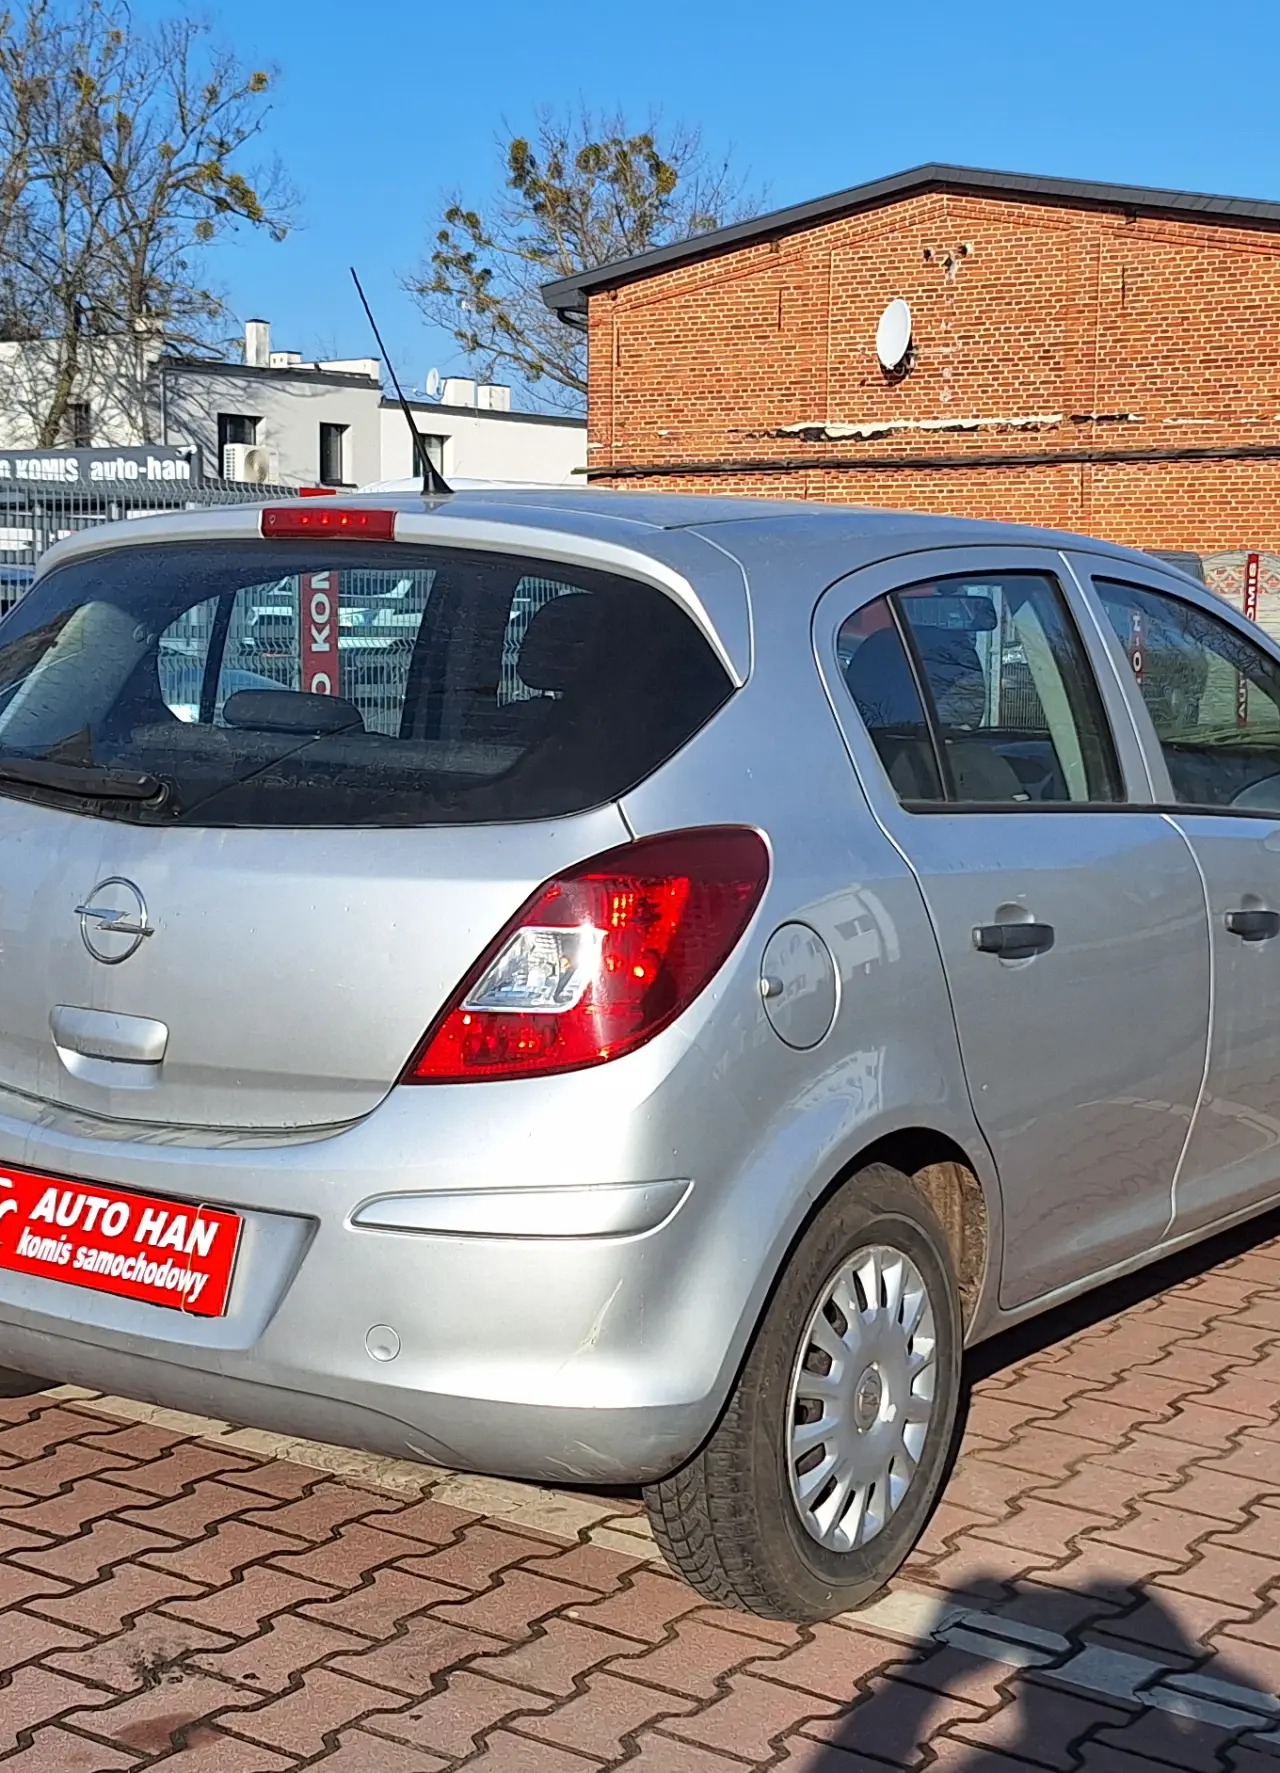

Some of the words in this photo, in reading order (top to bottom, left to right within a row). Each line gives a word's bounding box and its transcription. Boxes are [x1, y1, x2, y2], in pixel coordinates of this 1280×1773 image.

[15, 457, 79, 482] KOMIS
[90, 456, 190, 481] auto-han
[29, 1187, 130, 1237] AUTO
[134, 1212, 220, 1257] HAN
[16, 1225, 73, 1265] komis
[73, 1246, 210, 1303] samochodowy
